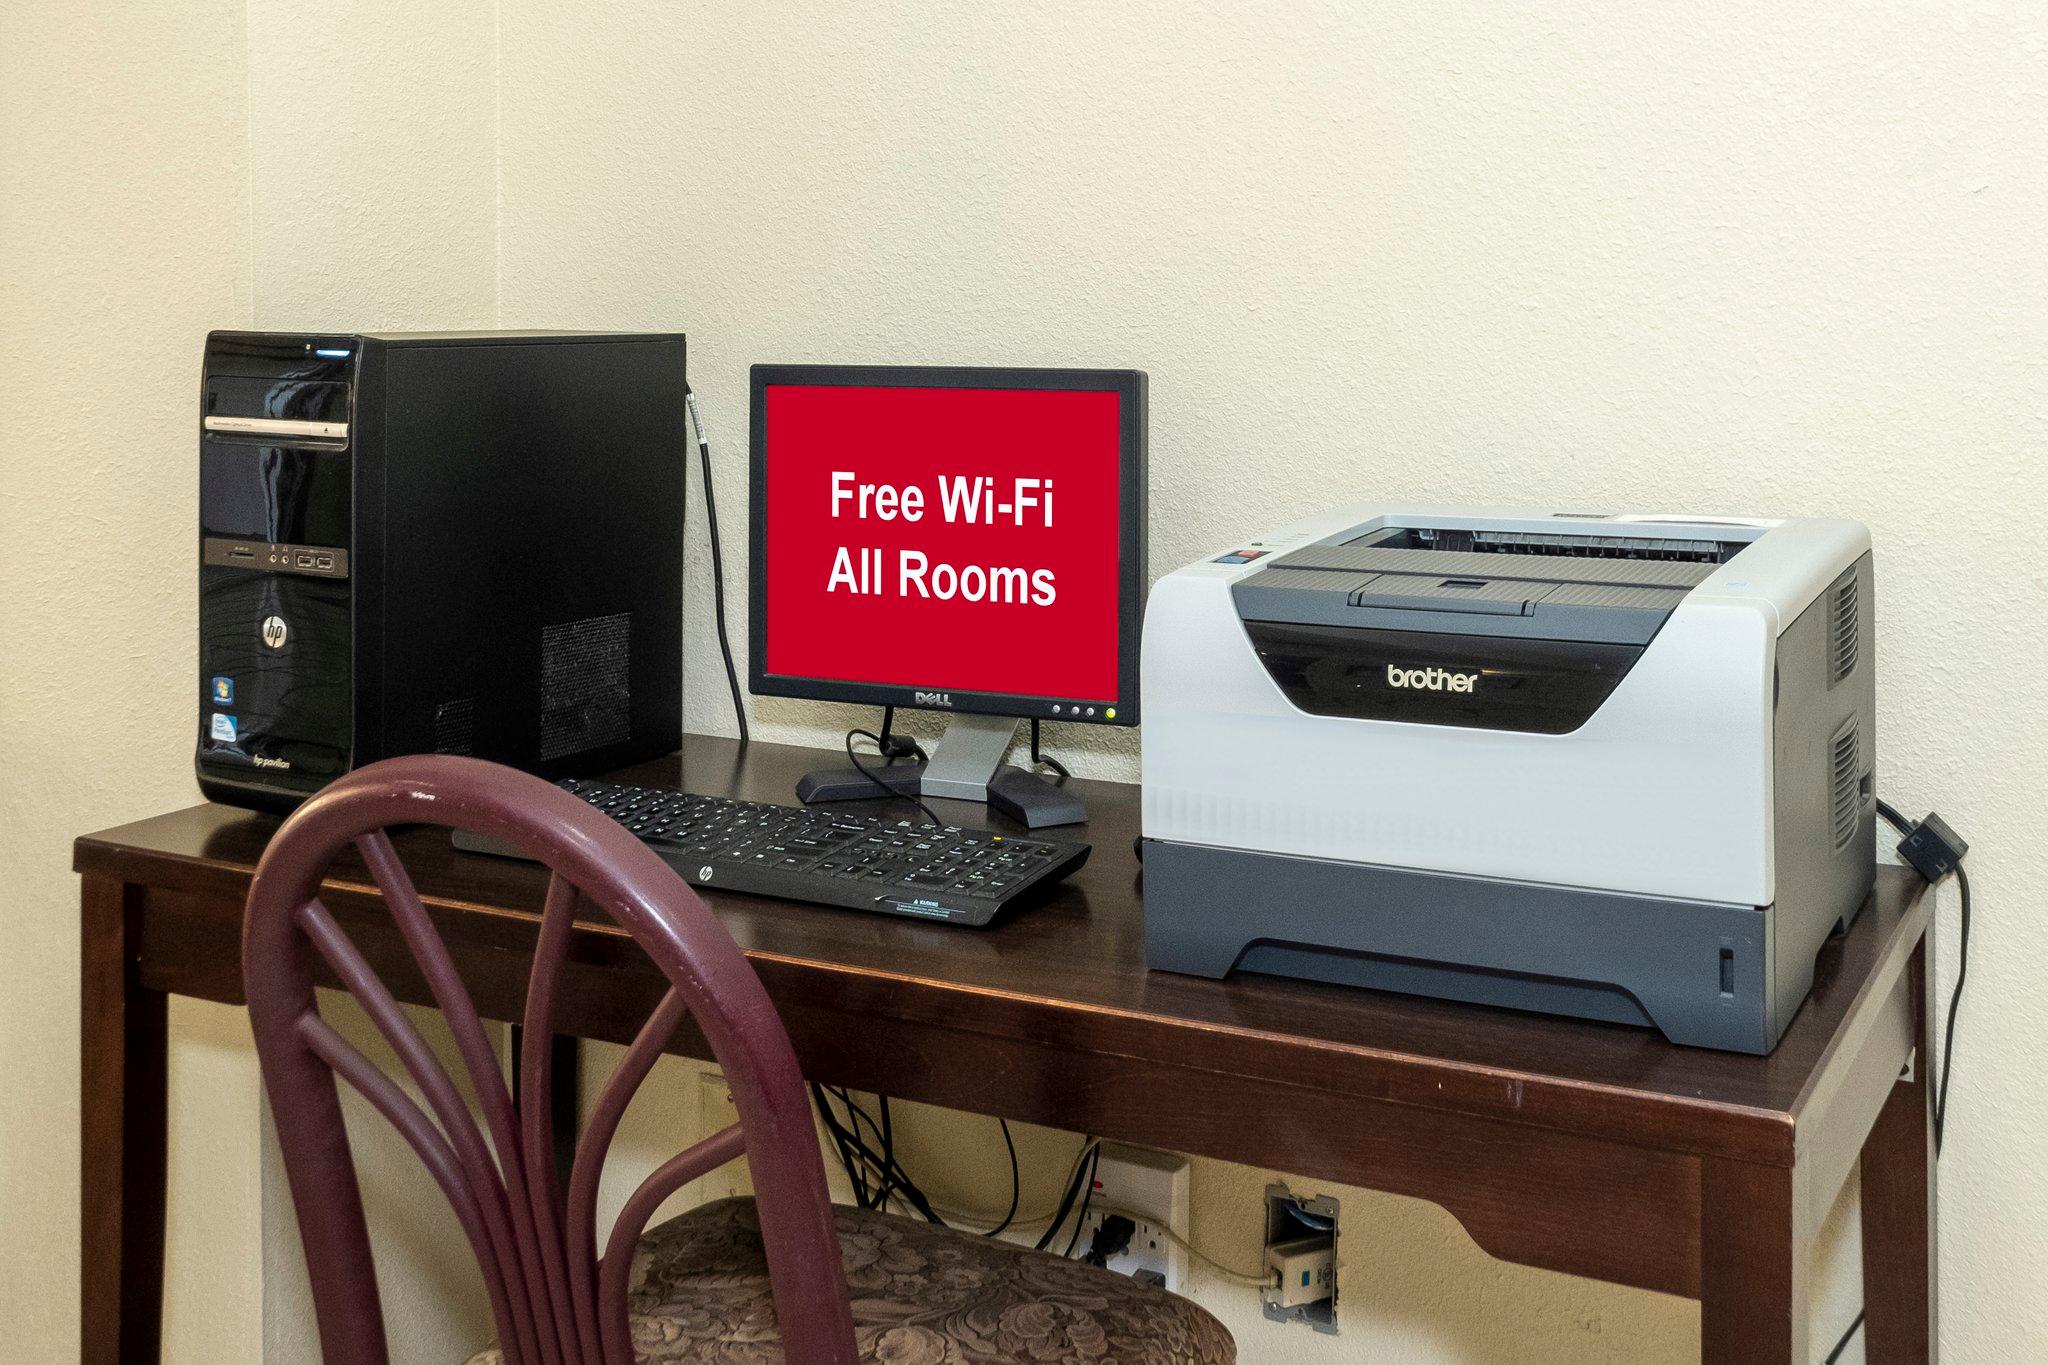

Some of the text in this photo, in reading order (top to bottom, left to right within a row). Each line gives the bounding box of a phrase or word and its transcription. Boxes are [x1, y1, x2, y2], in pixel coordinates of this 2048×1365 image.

[831, 471, 1053, 527] Free Wi-Fi
[826, 546, 1057, 607] All Rooms
[264, 616, 286, 648] hp
[1387, 664, 1478, 693] brother
[915, 691, 952, 706] DELL
[263, 757, 290, 769] pavilion
[699, 866, 713, 881] hp
